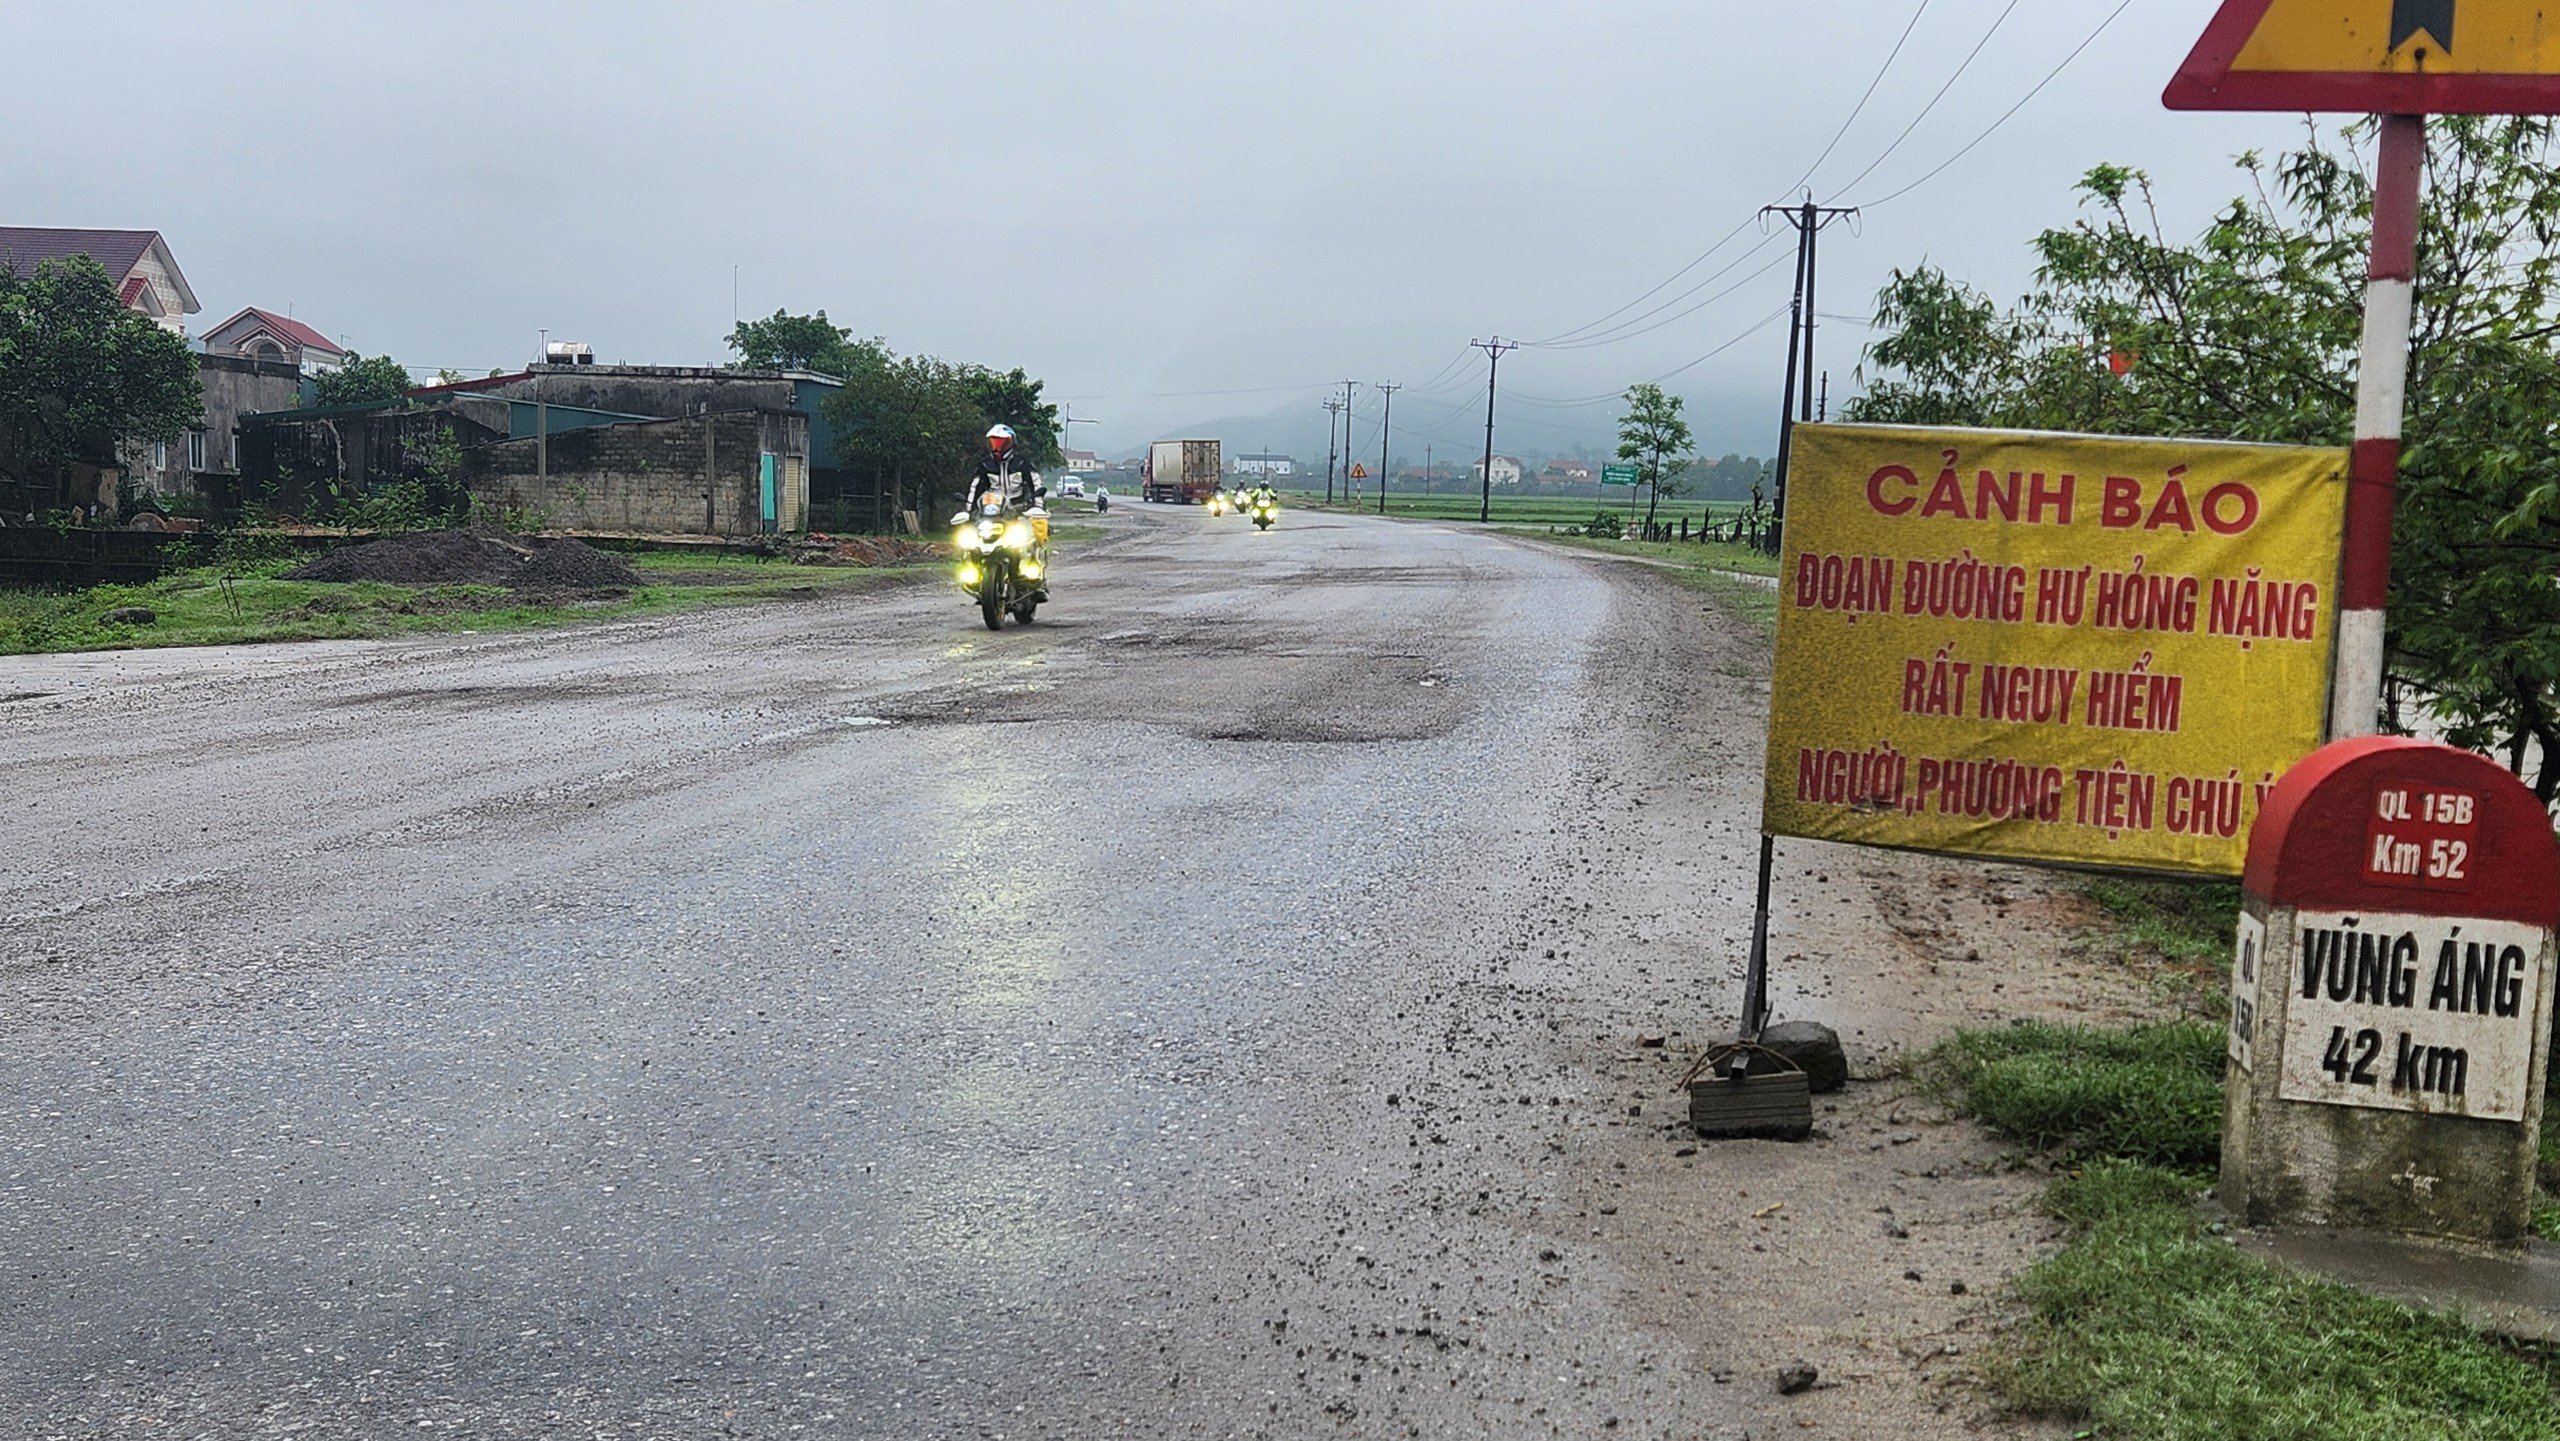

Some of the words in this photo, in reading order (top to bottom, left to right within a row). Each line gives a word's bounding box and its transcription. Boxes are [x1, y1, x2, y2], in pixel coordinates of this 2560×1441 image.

[1866, 448, 2075, 525] CẢNH
[2100, 463, 2260, 535] BÁO
[1796, 553, 1894, 624] ĐOẠN
[1903, 549, 2027, 623] ĐƯỜNG
[2035, 565, 2092, 627] HƯ
[2095, 554, 2199, 633] HỎNG
[2208, 567, 2318, 650] NẶNG
[1902, 641, 1971, 718] RẤT
[1979, 664, 2079, 726] NGUY
[2086, 651, 2183, 732] HIỂM
[2076, 758, 2155, 840] TIỆN
[2165, 768, 2242, 838] CHÚ
[2379, 790, 2412, 821] QL
[2423, 794, 2474, 824] 15B
[2373, 834, 2421, 875] Km
[2429, 839, 2467, 879] 52
[2302, 916, 2419, 1008] VŨNG
[2428, 925, 2526, 1018] ÁNG
[2322, 1026, 2382, 1086] 42
[2391, 1032, 2469, 1096] km
